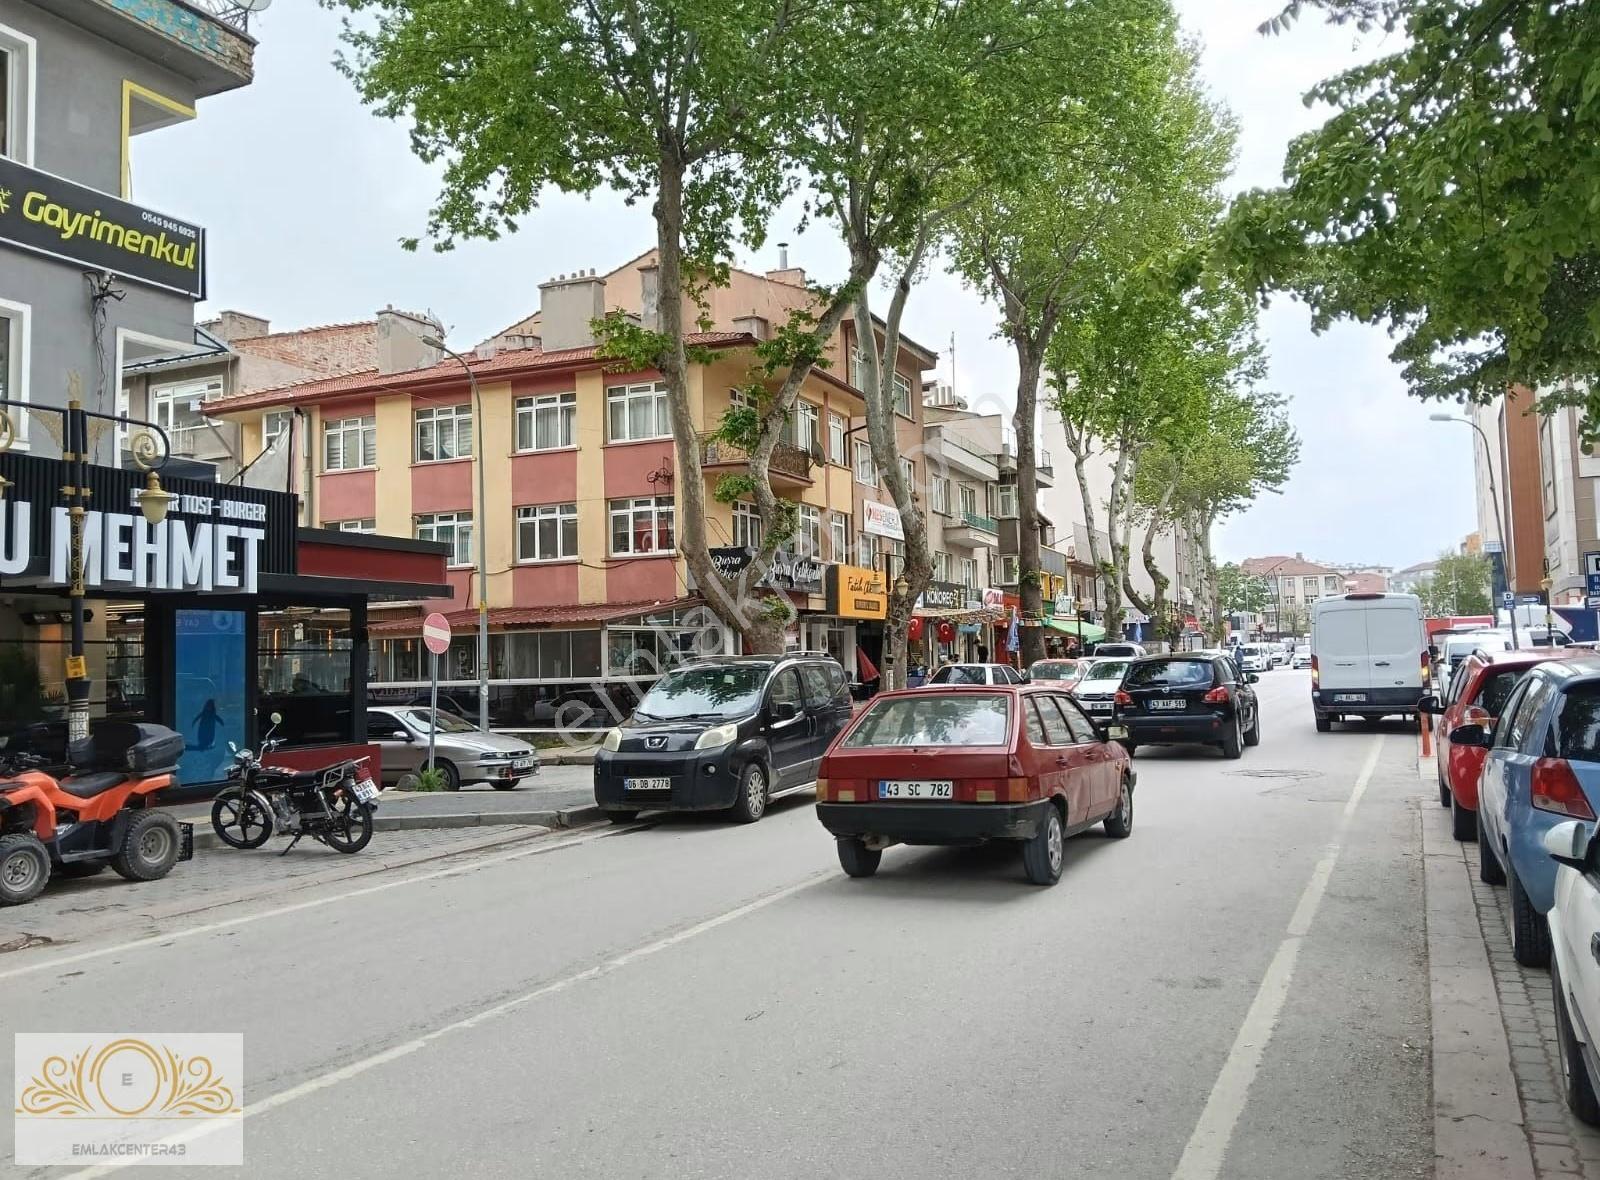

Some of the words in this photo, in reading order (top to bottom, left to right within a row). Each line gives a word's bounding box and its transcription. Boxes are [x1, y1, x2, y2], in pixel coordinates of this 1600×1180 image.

[22, 190, 197, 270] Gayrimenkul
[51, 506, 265, 594] MEHMET
[887, 784, 900, 796] 43
[908, 784, 921, 796] SC
[930, 784, 950, 796] 782
